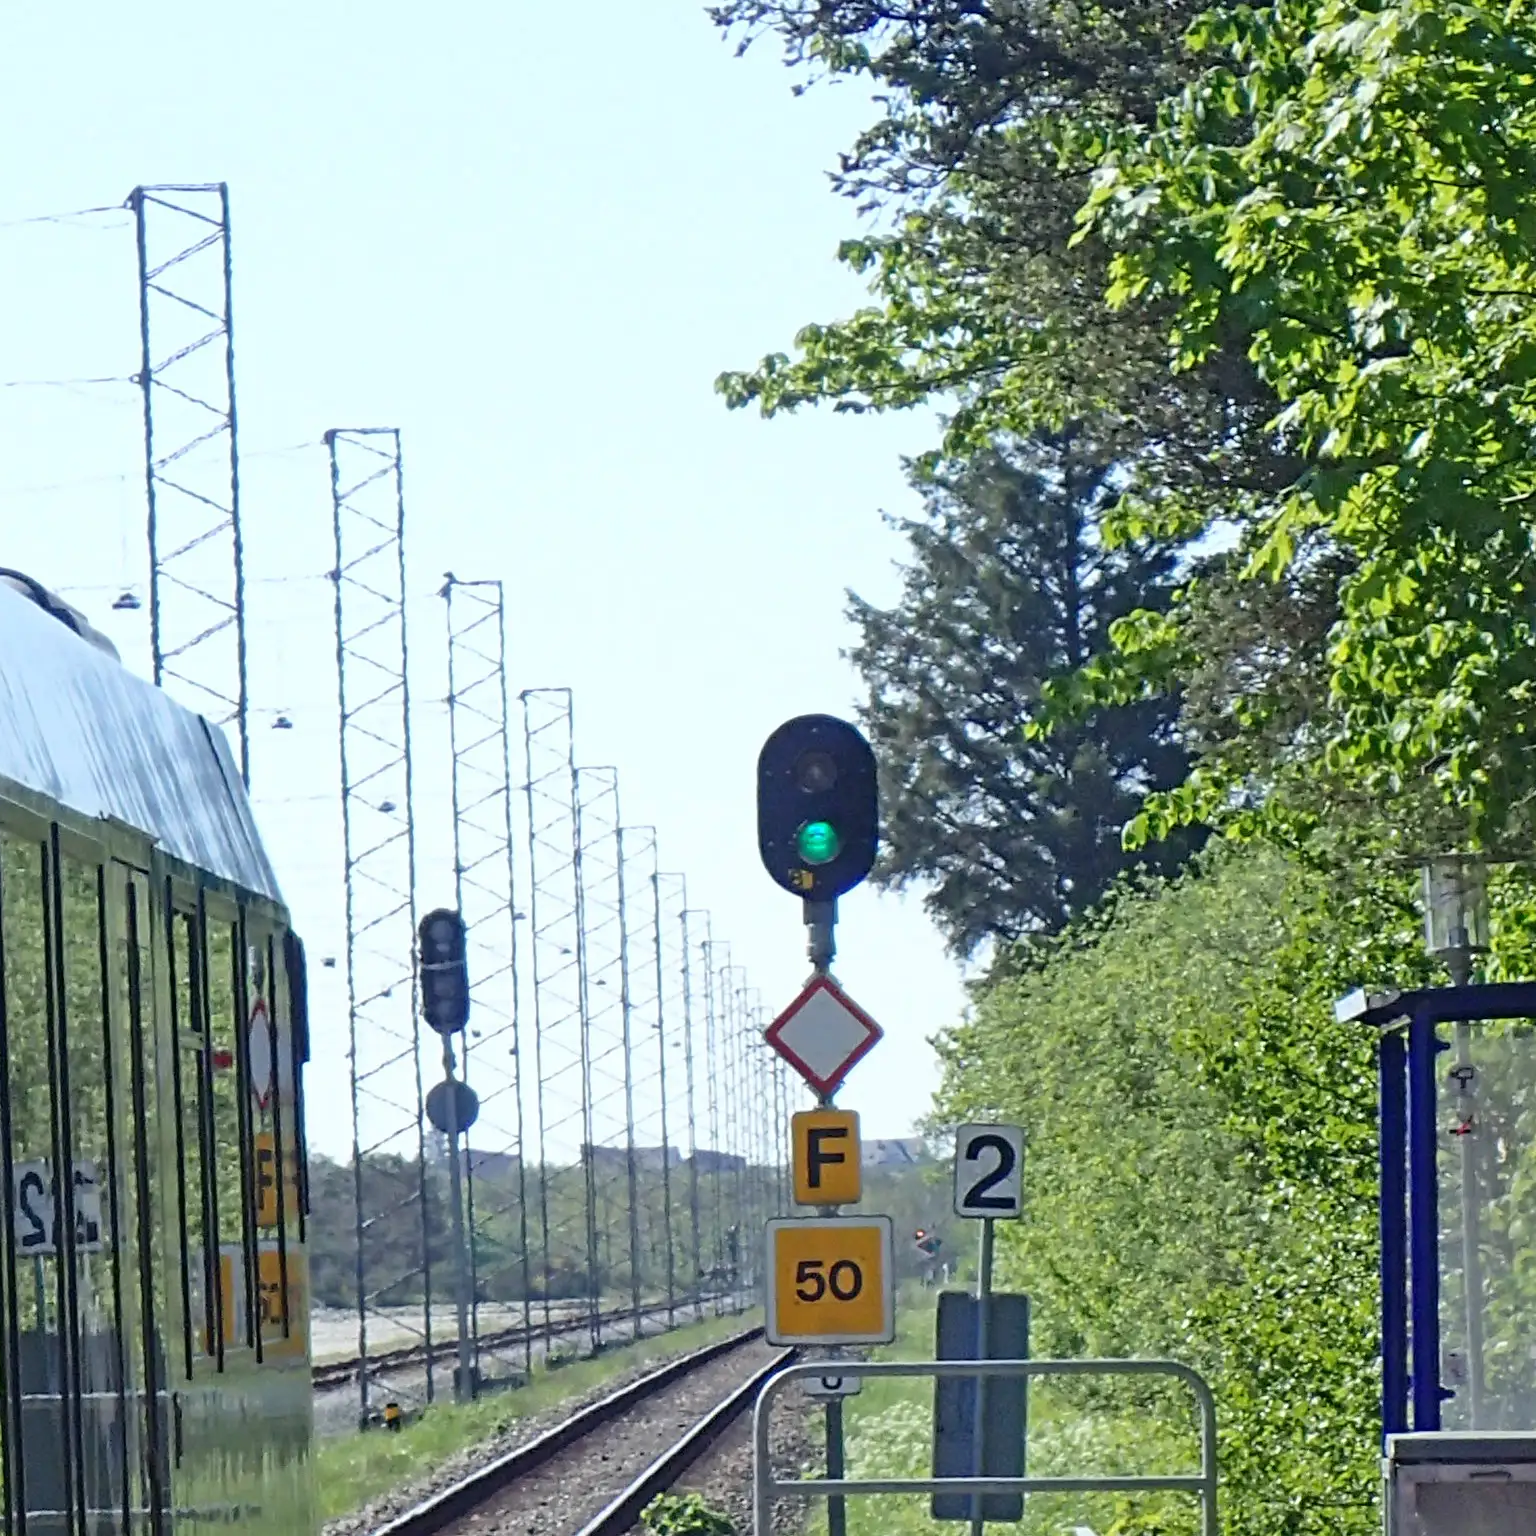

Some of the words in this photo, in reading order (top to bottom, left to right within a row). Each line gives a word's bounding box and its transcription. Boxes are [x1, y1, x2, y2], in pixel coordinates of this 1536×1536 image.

[807, 1126, 848, 1189] F
[962, 1133, 1016, 1210] 2
[795, 1258, 863, 1303] 50
